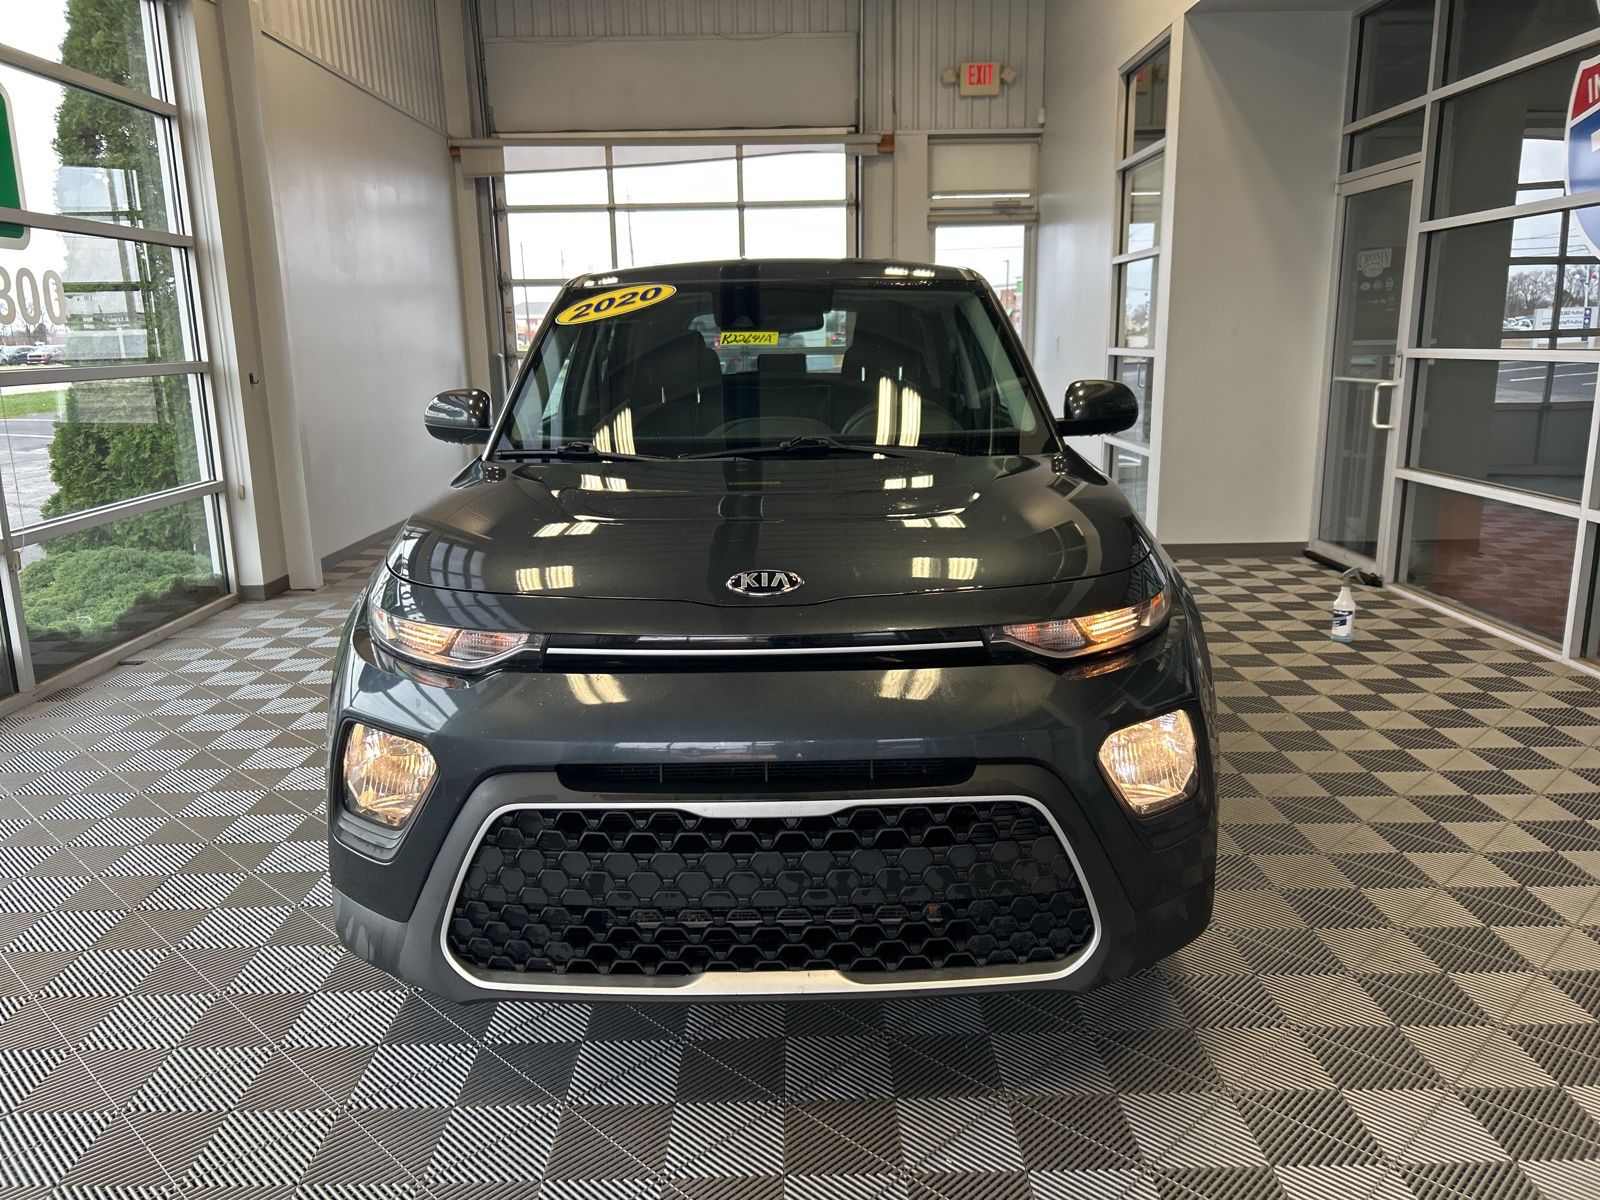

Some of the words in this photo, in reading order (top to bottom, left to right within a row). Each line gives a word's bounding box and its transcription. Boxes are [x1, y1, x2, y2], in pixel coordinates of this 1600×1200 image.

[967, 64, 993, 86] EXIT
[568, 287, 663, 322] 2020
[740, 572, 791, 588] KIA
